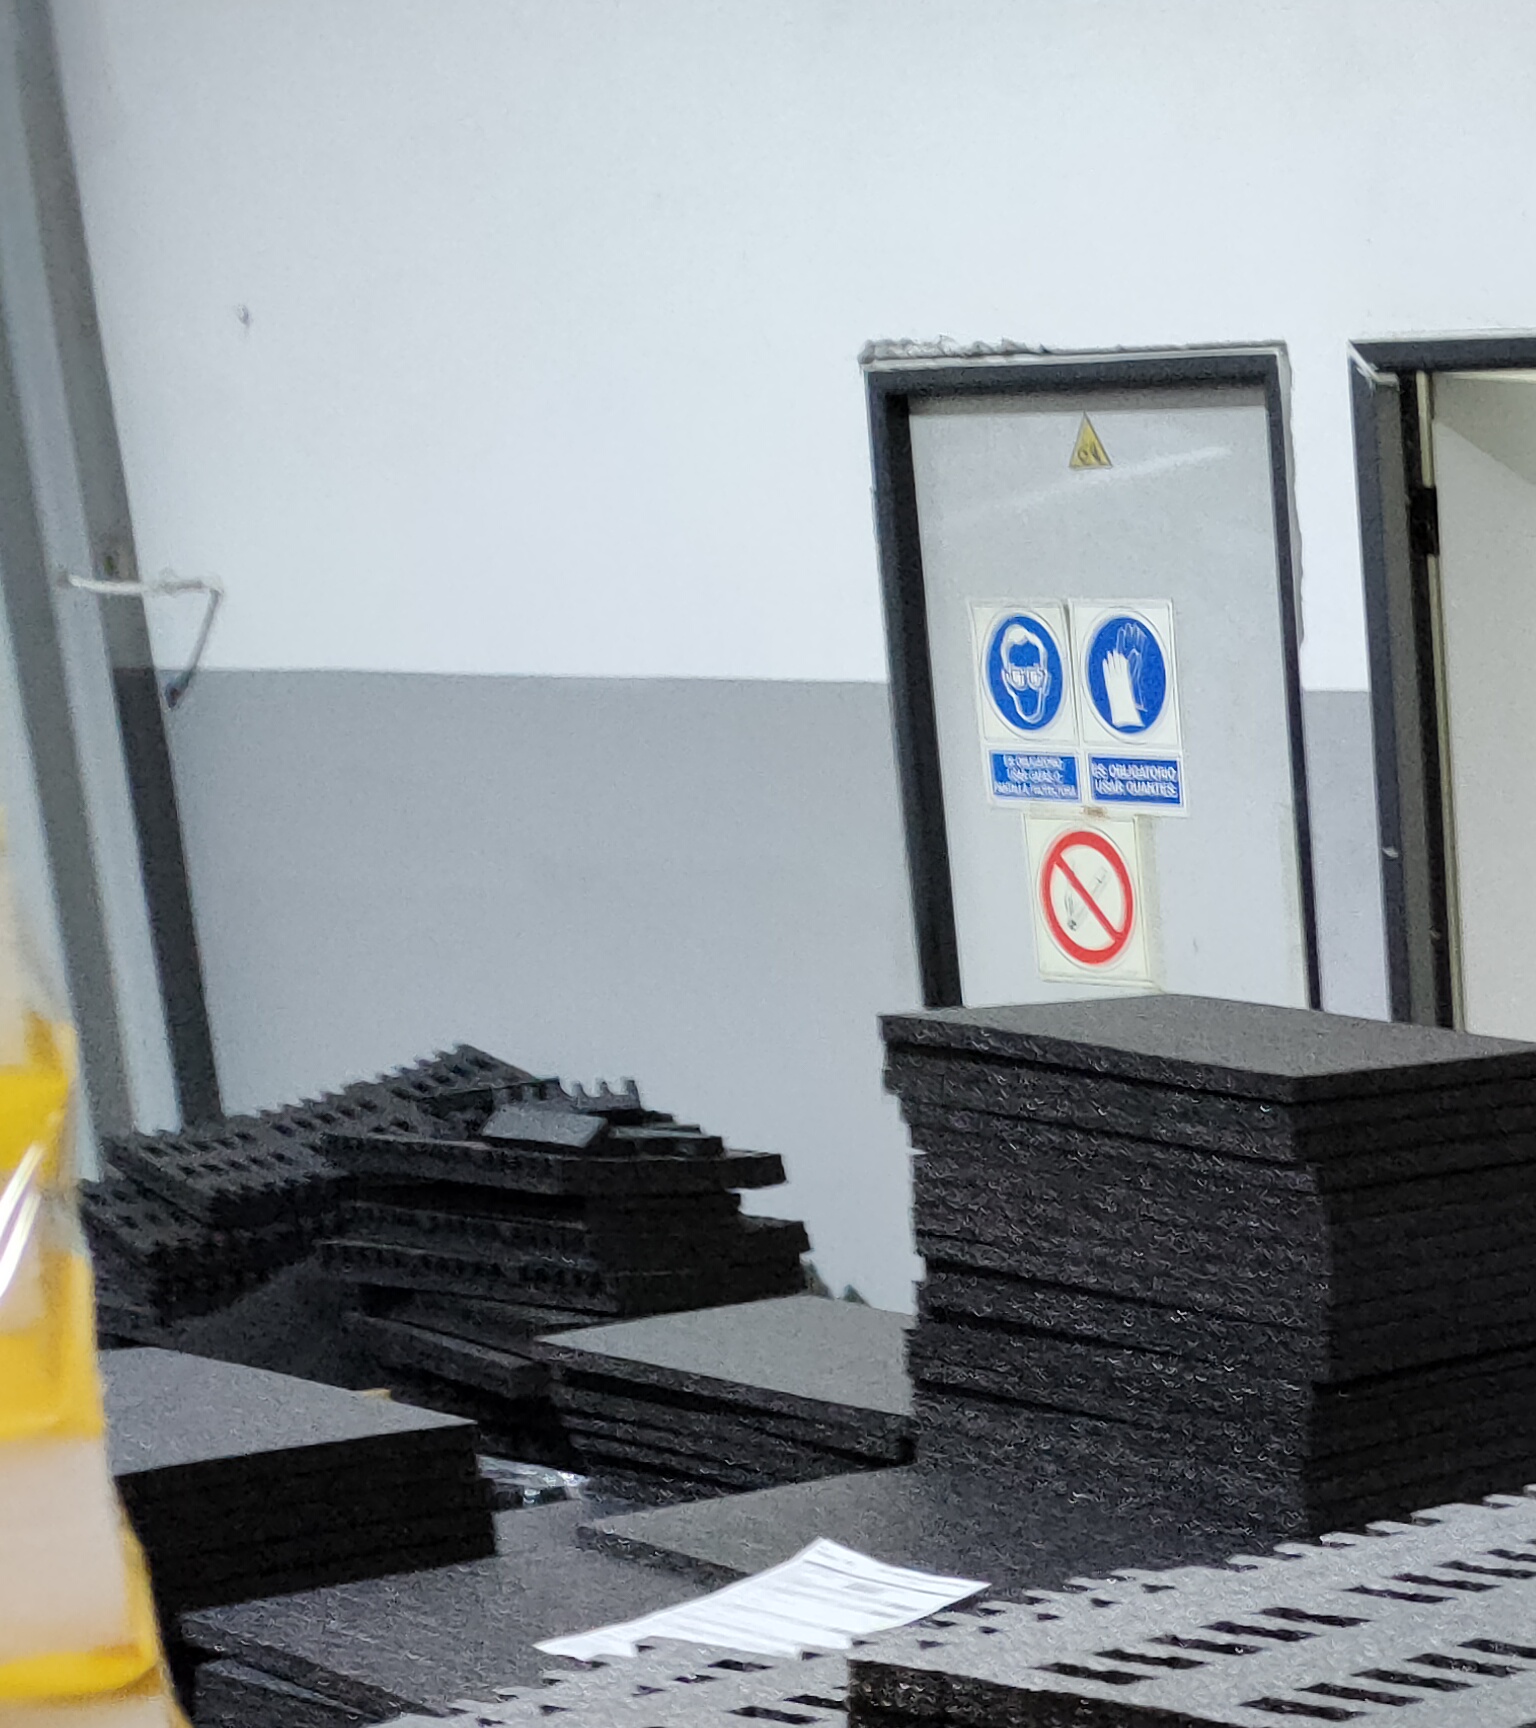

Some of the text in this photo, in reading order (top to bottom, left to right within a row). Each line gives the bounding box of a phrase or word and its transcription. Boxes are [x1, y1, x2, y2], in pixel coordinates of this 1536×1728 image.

[1109, 763, 1177, 782] OBLIGATORIO
[1095, 778, 1126, 795] USAR
[1126, 780, 1179, 797] GUANTES
